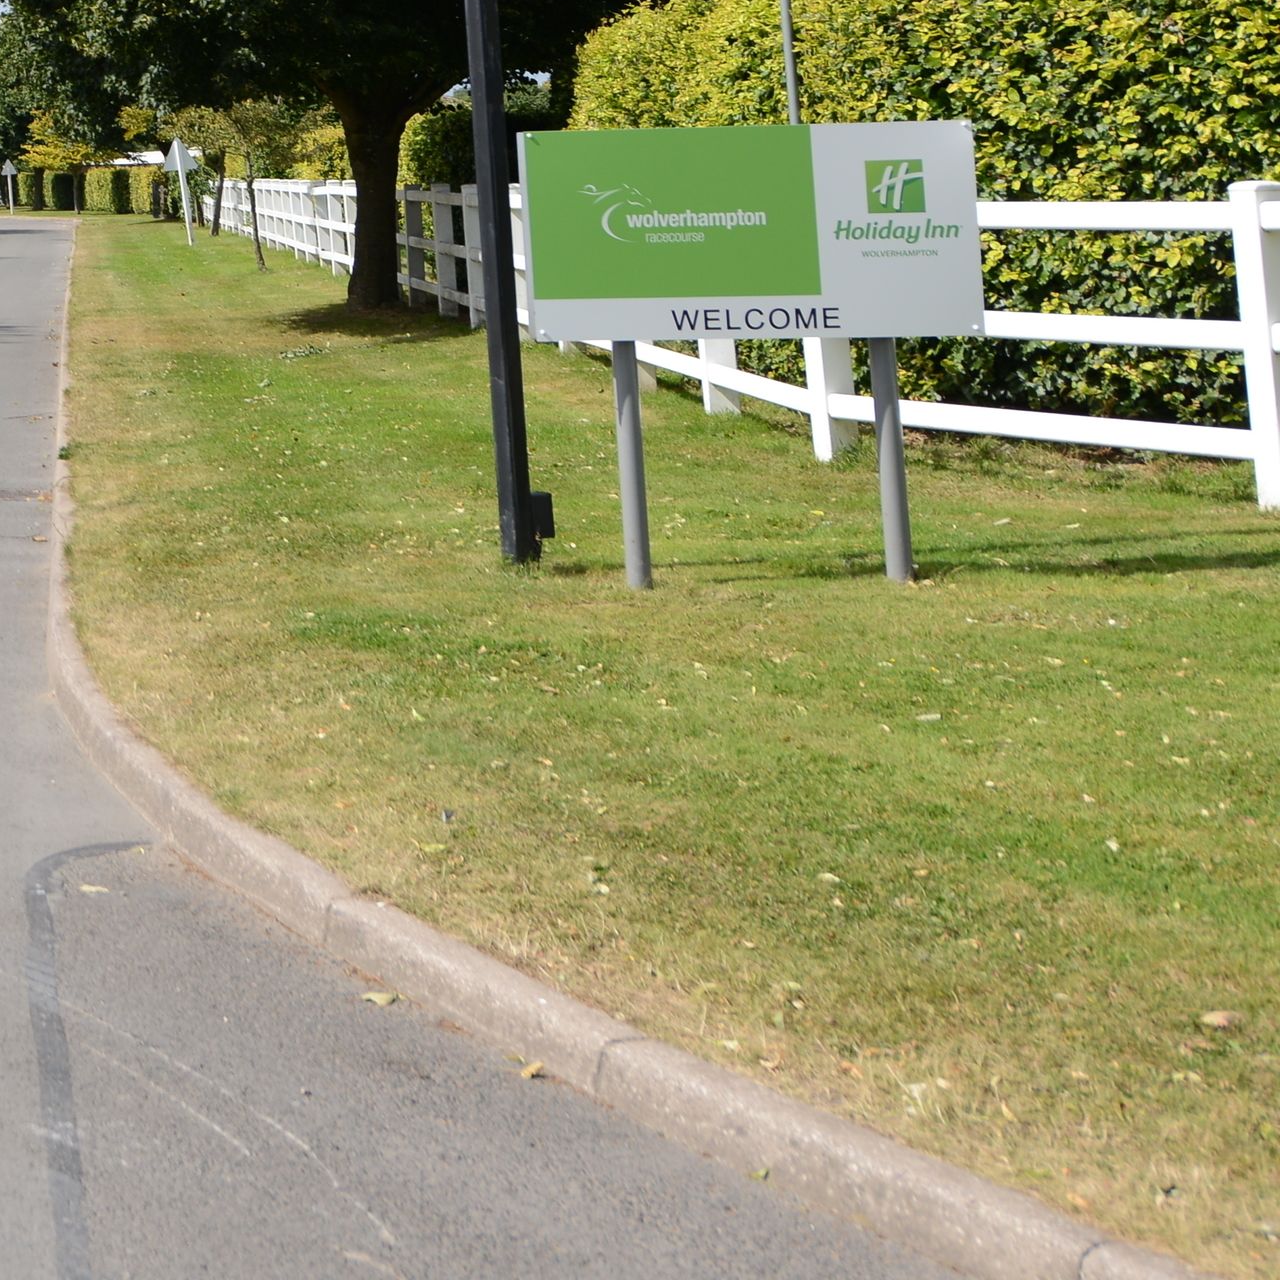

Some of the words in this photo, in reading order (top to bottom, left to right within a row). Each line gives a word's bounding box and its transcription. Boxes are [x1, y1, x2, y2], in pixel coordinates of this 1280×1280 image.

[626, 209, 767, 230] wolverhampton
[645, 231, 705, 244] racecourse
[833, 219, 921, 245] Holiday
[924, 218, 960, 239] Inn
[861, 248, 939, 258] WOLVERHAMPTON
[671, 307, 842, 331] WELCOME
